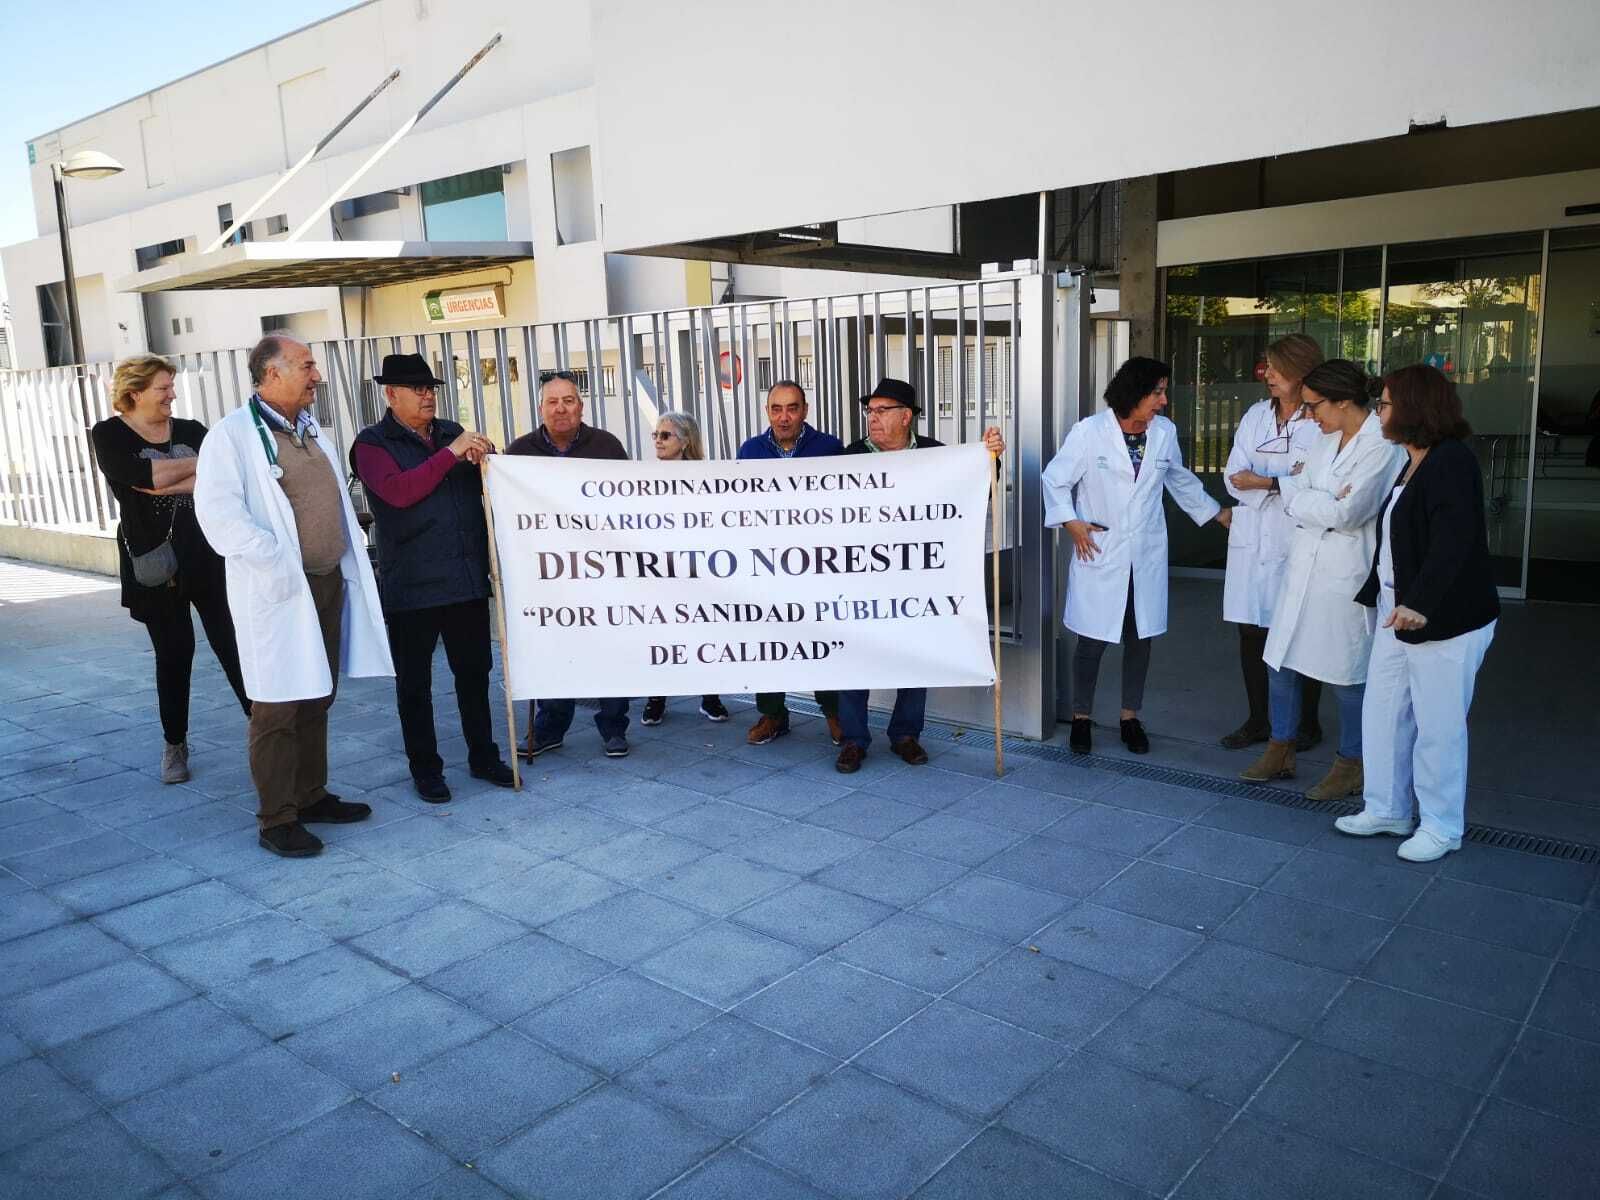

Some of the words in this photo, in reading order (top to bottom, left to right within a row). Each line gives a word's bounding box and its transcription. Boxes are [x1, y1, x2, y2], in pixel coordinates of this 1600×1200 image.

[446, 296, 494, 313] URGENCIAS
[581, 477, 782, 497] COORDINADORA
[787, 471, 895, 491] VECINAL
[518, 513, 548, 530] DE
[556, 512, 675, 530] USUARIOS
[683, 511, 713, 528] DE
[721, 508, 833, 527] CENTROS
[842, 506, 871, 523] DE
[879, 503, 962, 522] SALUD.
[537, 549, 737, 579] DISTRITO
[749, 541, 945, 576] NORESTE
[523, 606, 597, 627] “POR
[607, 604, 667, 626] UNA
[675, 602, 804, 623] SANIDAD
[815, 595, 938, 621] PÚBLICA
[946, 595, 964, 615] Y
[648, 644, 687, 665] DE
[697, 640, 844, 663] CALIDAD”
